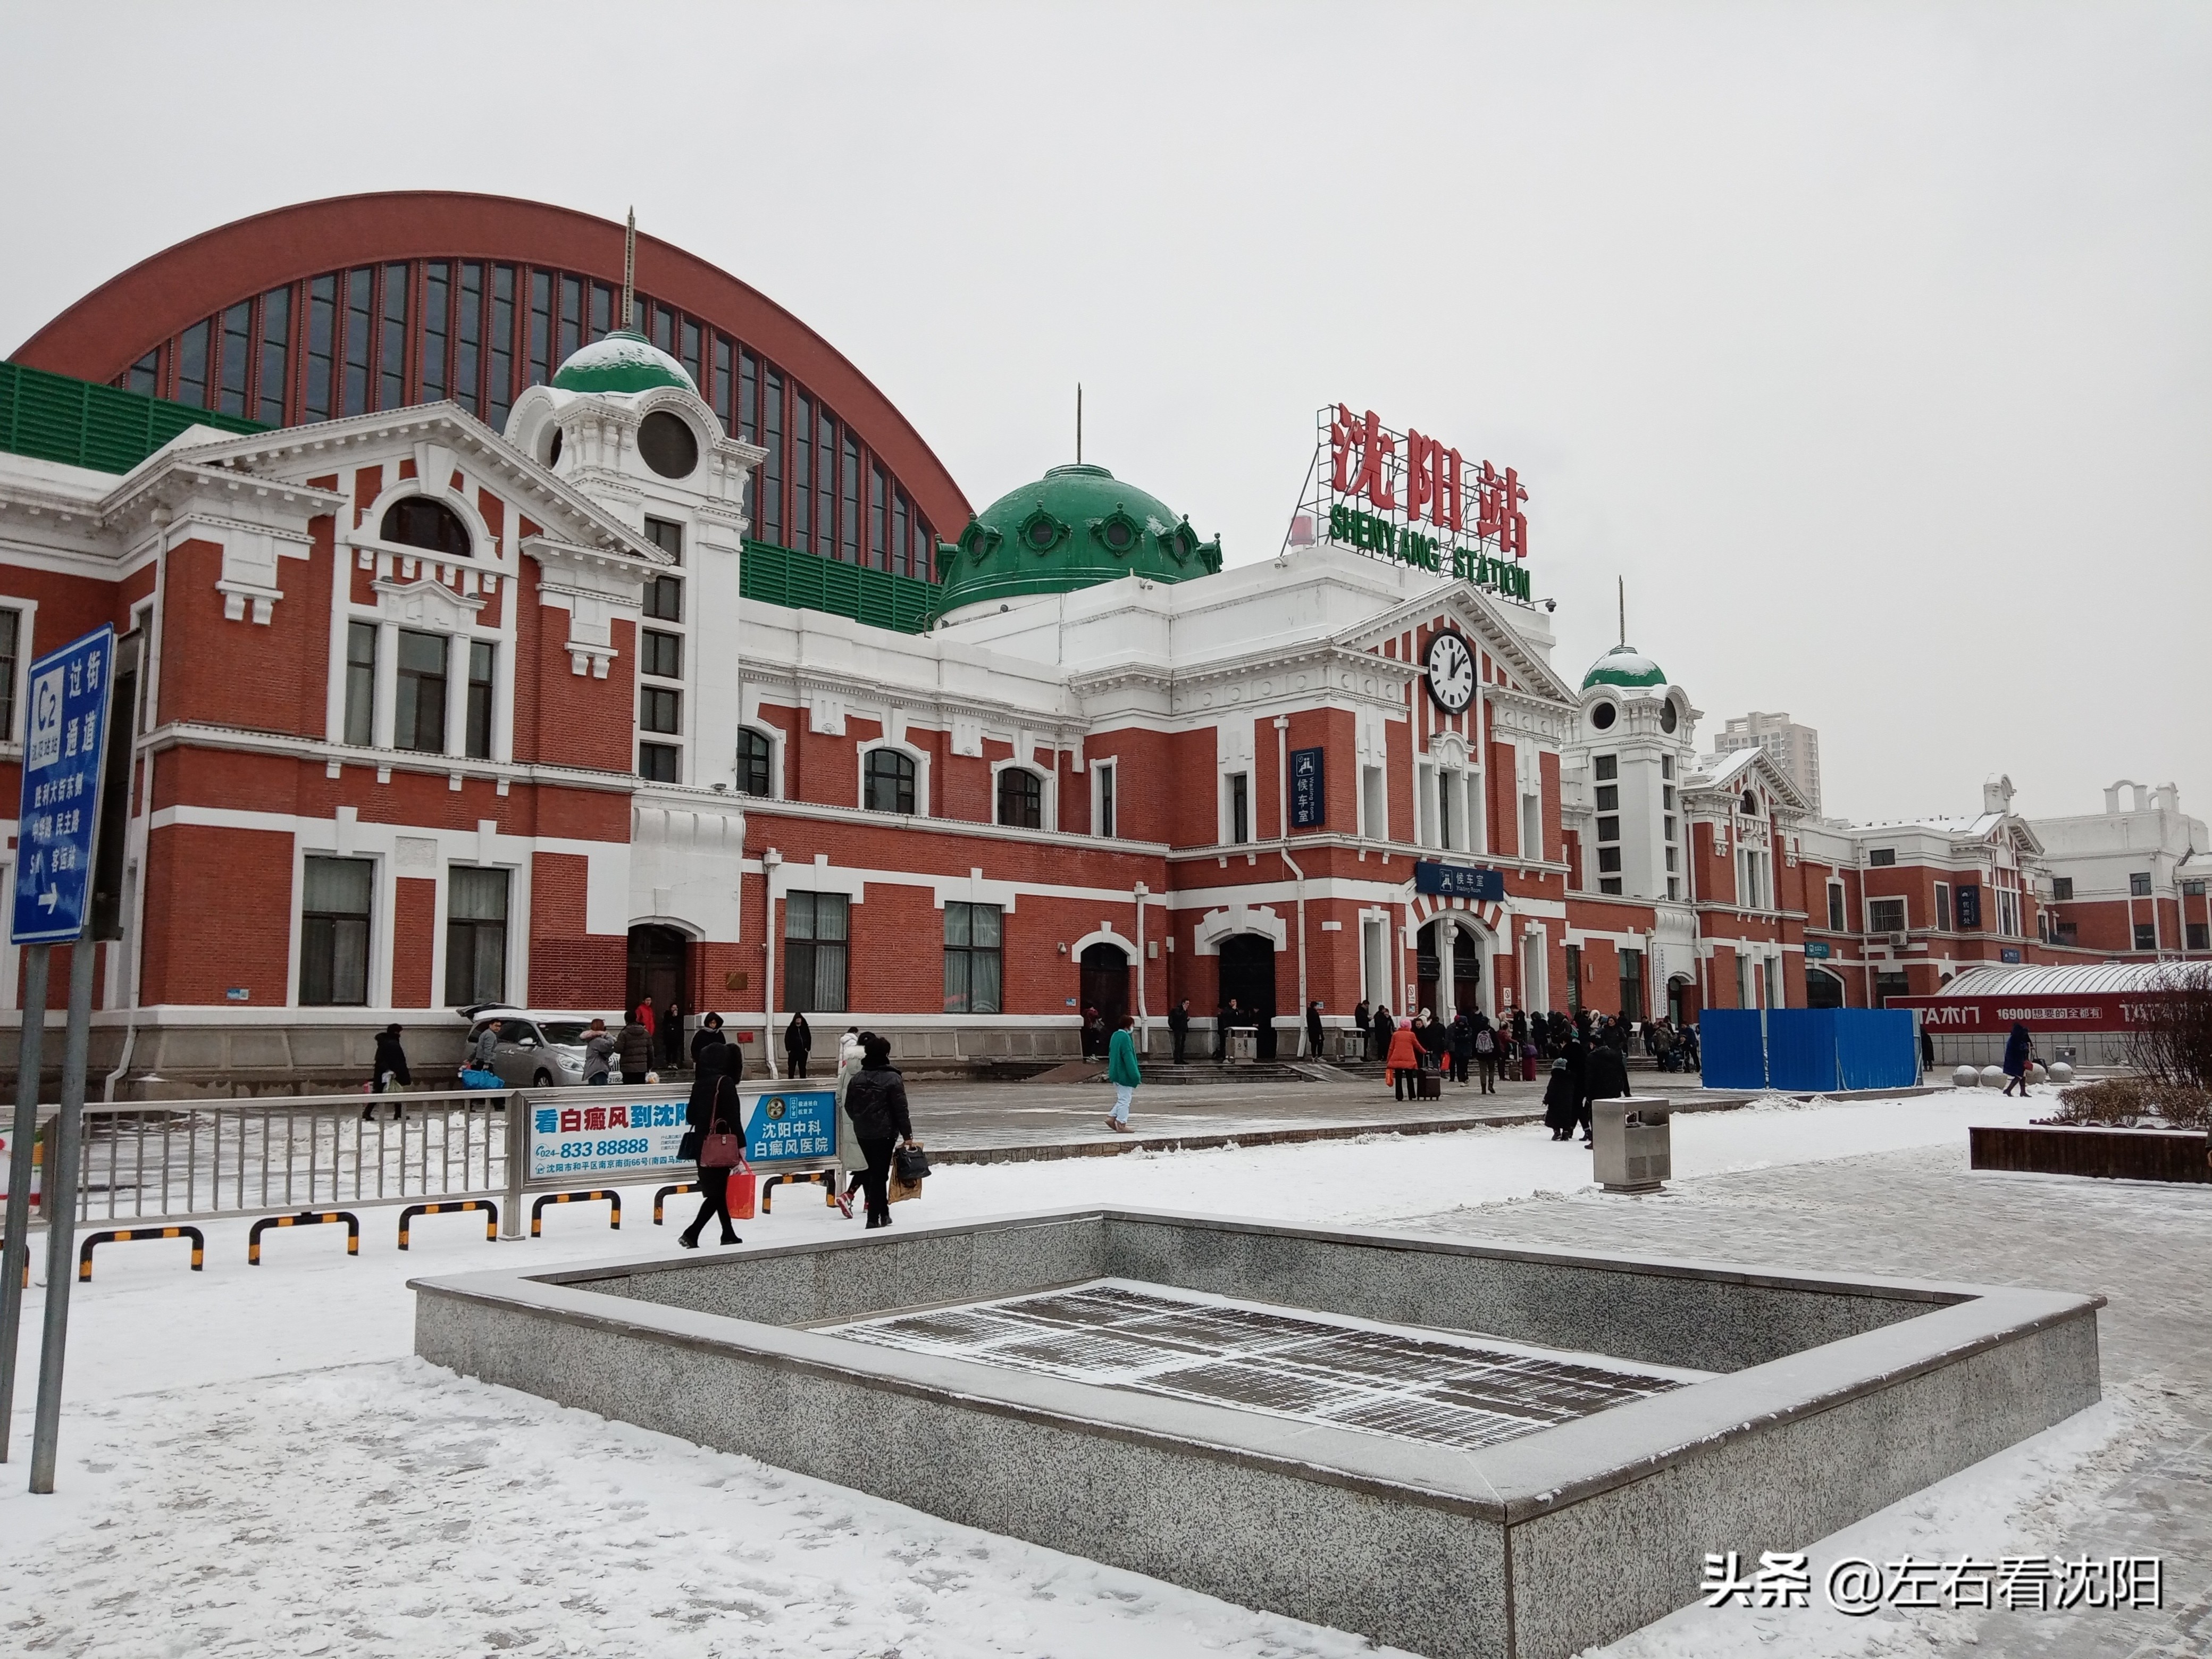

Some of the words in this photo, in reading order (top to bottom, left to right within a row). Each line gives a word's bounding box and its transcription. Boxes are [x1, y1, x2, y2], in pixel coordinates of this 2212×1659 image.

[1330, 403, 1529, 558] 沈阳站
[1330, 504, 1439, 572] SHENYANG
[1453, 546, 1530, 601] STATION
[69, 650, 101, 699] 过街
[38, 681, 56, 732] C2
[65, 709, 96, 759] 通道
[34, 772, 83, 809] 胜利大街东侧
[1297, 778, 1309, 823] 候车室
[1456, 872, 1484, 887] 候车室
[596, 1138, 648, 1156] 88888
[754, 1137, 828, 1158] 白癜风医院
[761, 1119, 822, 1139] 沈阳中科
